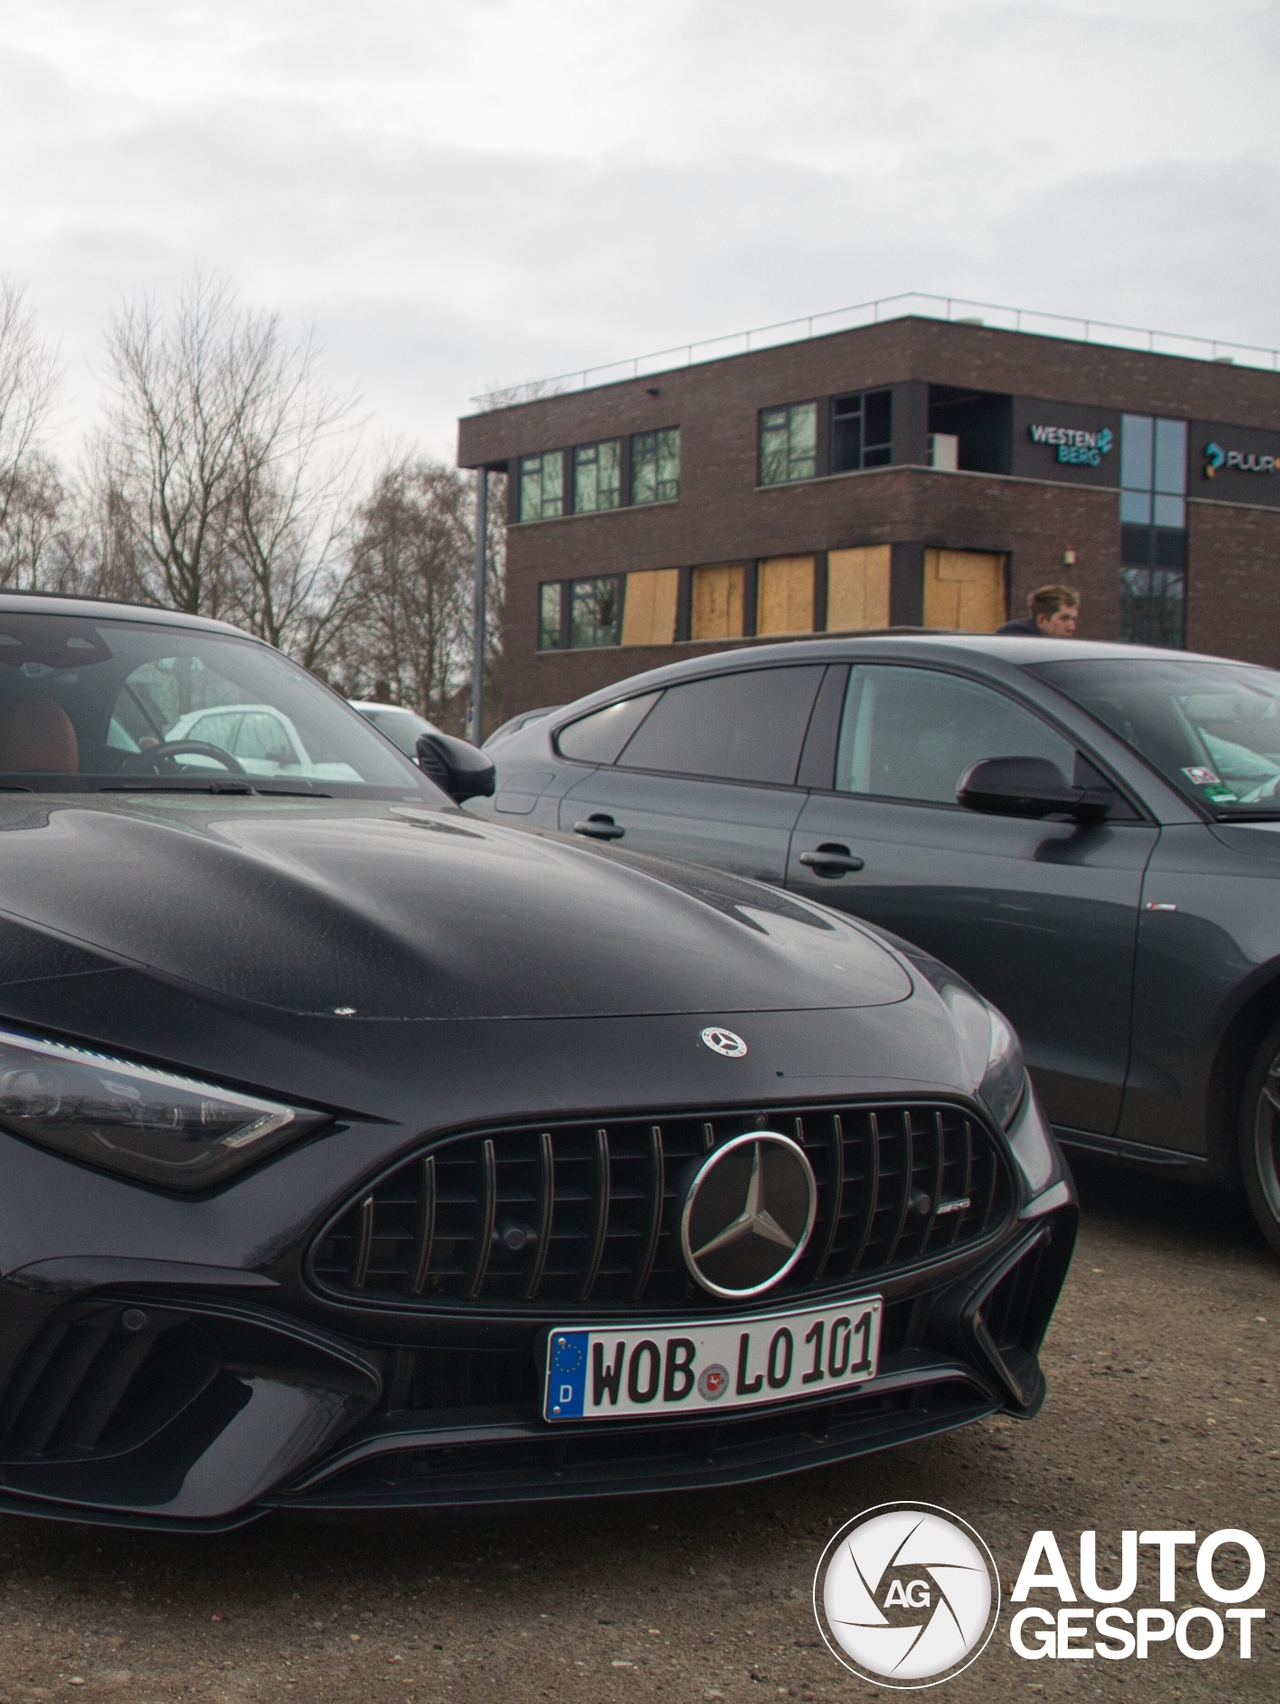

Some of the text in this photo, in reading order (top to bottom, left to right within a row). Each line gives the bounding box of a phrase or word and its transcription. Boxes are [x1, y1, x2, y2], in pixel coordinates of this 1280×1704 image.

[1029, 424, 1096, 448] WESTEN
[1057, 444, 1100, 467] BERG
[592, 1337, 696, 1406] WOB
[560, 1385, 572, 1403] D
